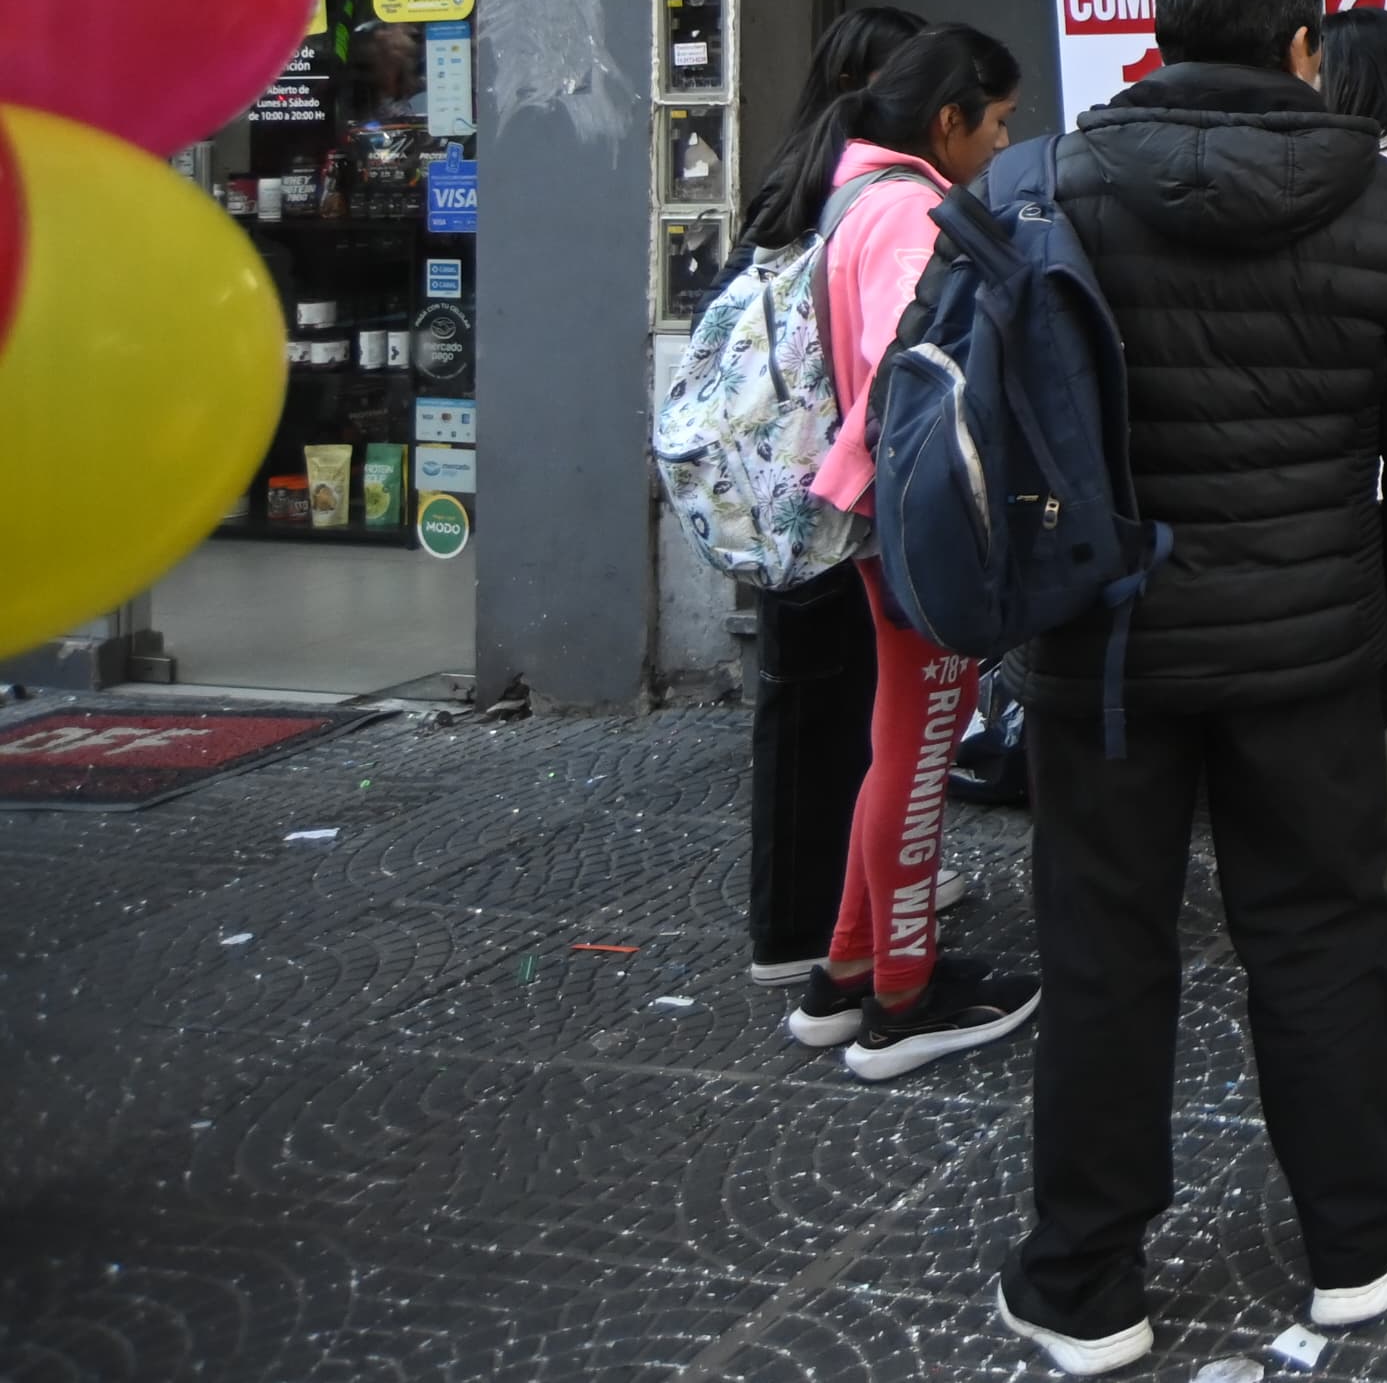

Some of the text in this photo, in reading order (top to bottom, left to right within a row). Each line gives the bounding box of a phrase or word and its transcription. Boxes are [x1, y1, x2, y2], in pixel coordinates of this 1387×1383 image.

[301, 47, 315, 58] de
[432, 189, 478, 208] VISA
[423, 342, 462, 352] mercado
[432, 351, 454, 362] pago
[426, 523, 460, 535] MODO
[939, 654, 960, 685] 78
[898, 687, 962, 868] RUNNING
[888, 876, 933, 958] WAY
